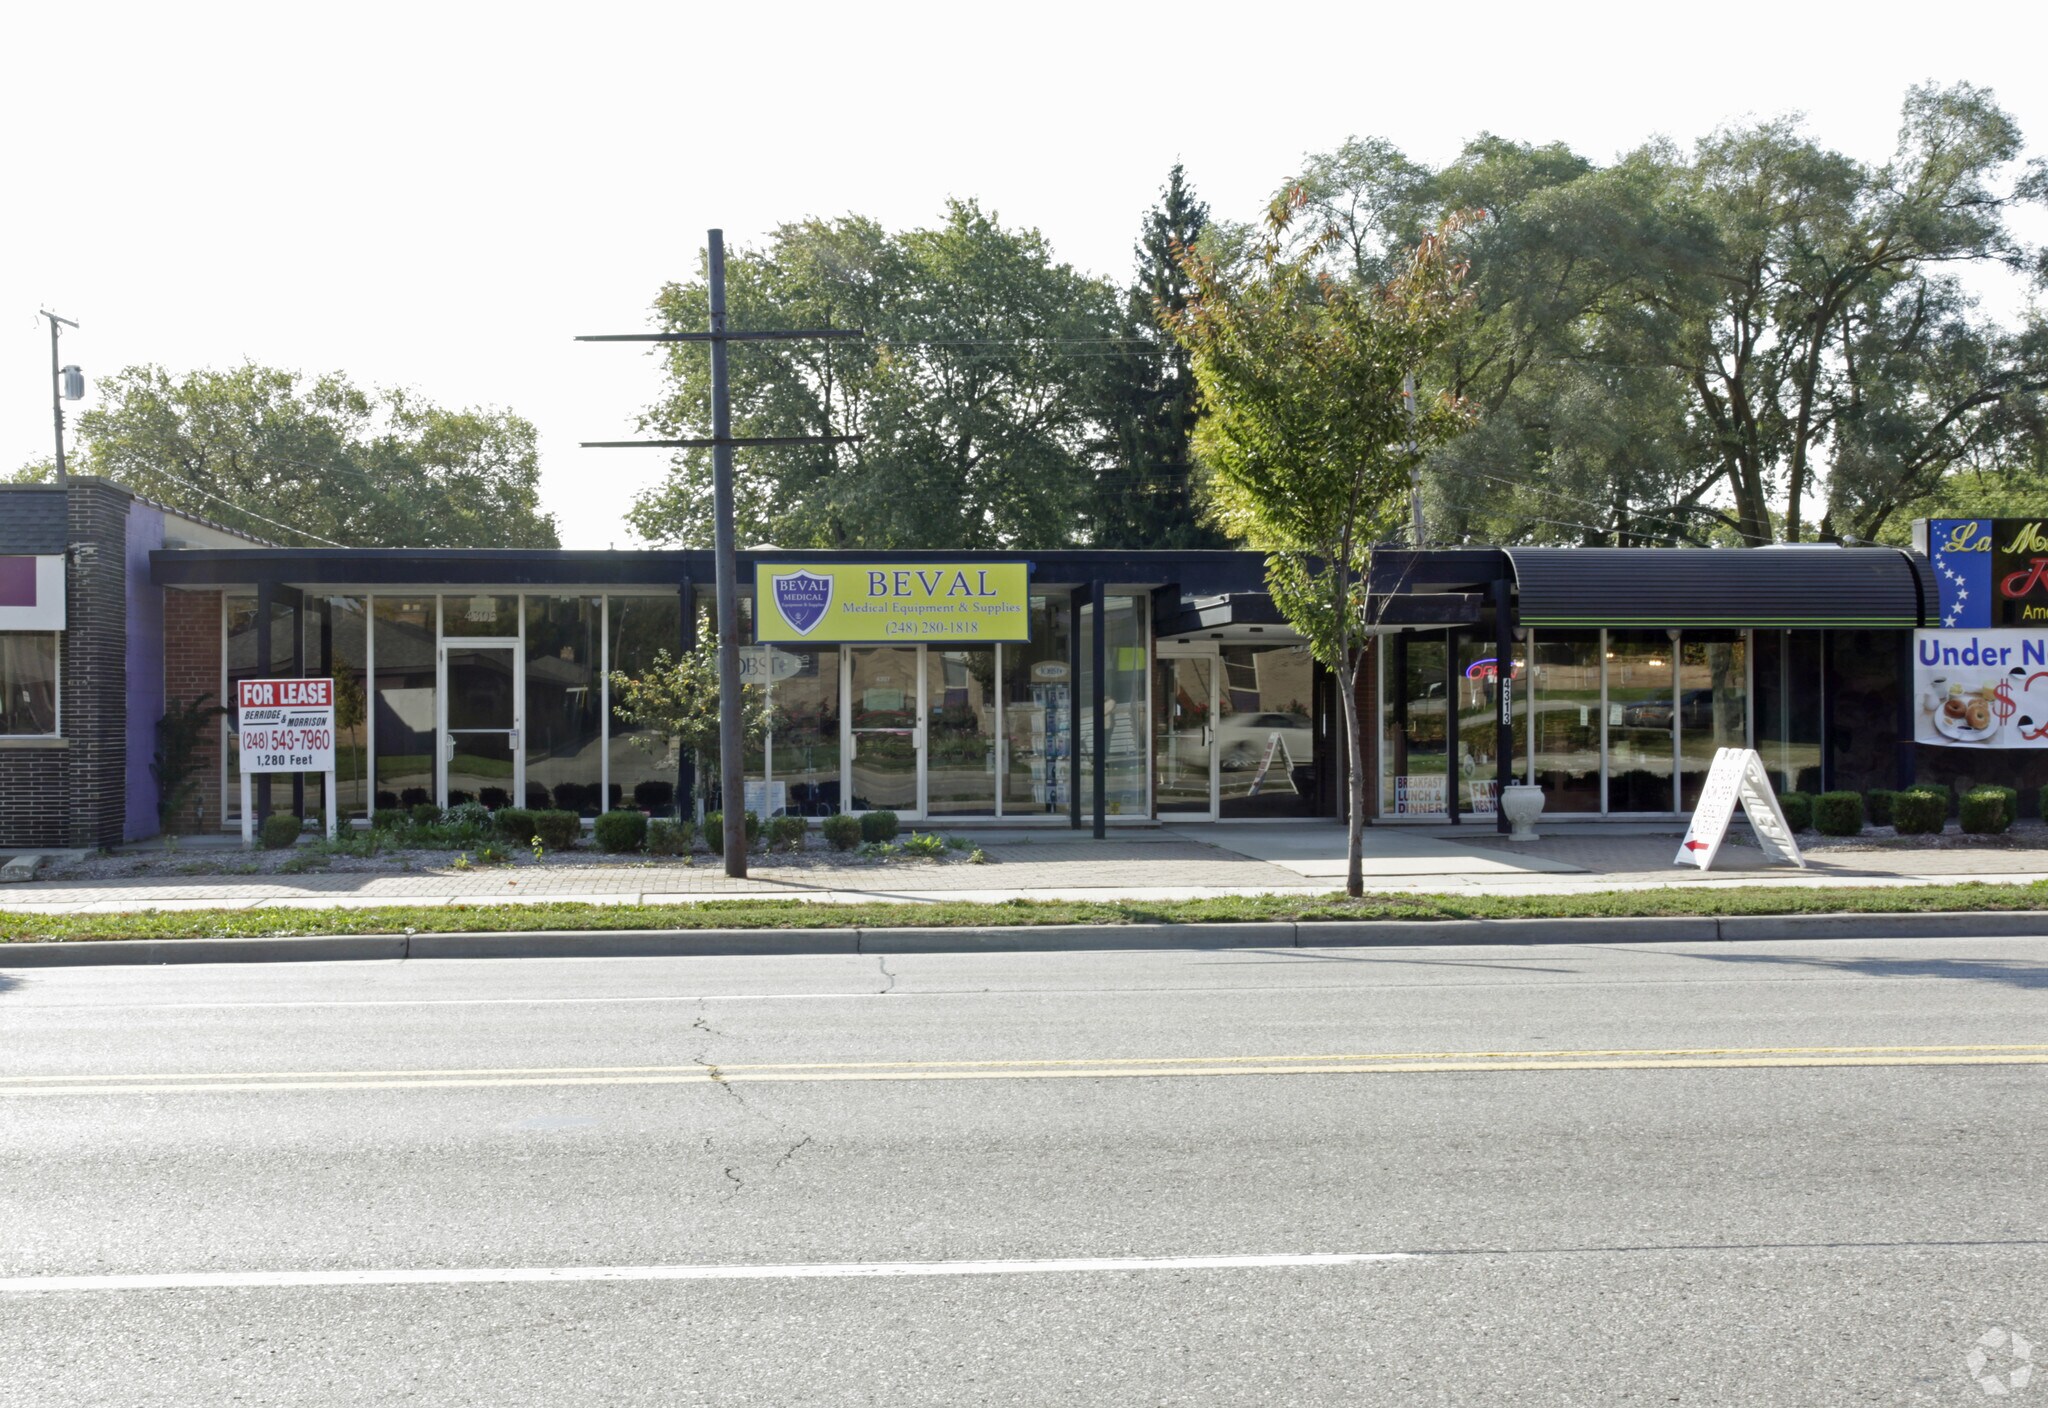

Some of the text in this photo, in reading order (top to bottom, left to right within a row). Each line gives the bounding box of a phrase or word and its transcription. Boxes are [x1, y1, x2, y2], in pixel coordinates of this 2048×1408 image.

[1944, 522, 1992, 552] La
[780, 580, 827, 591] BEVAL
[867, 570, 997, 597] BEVAL
[783, 593, 823, 601] MEDICAL
[842, 602, 1021, 615] Medical Equipment & Supplies
[2022, 604, 2048, 619] Am
[885, 621, 978, 635] (248) 280-1818
[1919, 637, 2048, 666] Under N
[243, 682, 327, 705] FOR LEASE
[244, 710, 327, 727] BERRIDGE & MORRISON
[242, 729, 330, 751] (248) 543-7960
[257, 754, 313, 766] 1,280 Feet
[1397, 777, 1443, 789] BREAKFAST
[1398, 790, 1441, 801] LUNCH &
[1471, 782, 1498, 799] FAM
[1398, 803, 1442, 814] DINNER
